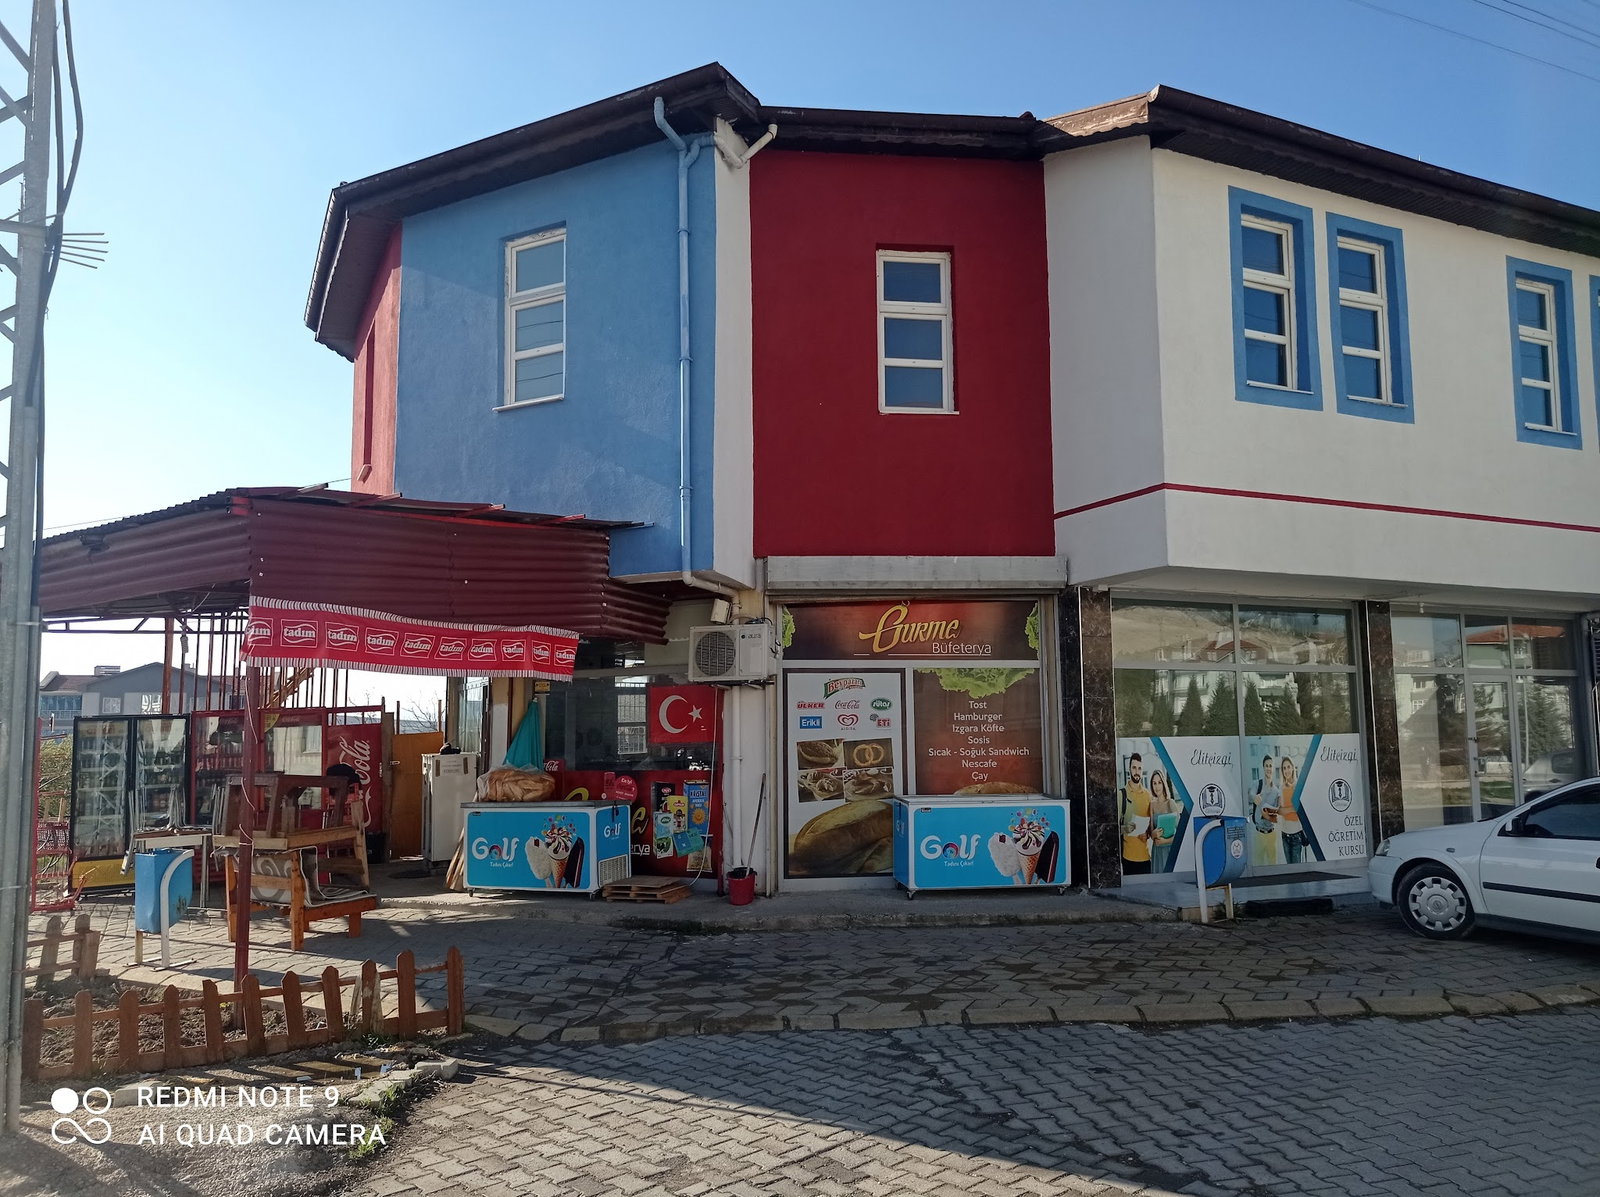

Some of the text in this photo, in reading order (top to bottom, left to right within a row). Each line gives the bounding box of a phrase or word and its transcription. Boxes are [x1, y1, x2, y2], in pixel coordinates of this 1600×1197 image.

[284, 627, 316, 639] tadım
[858, 604, 960, 653] Gurme
[328, 630, 358, 642] tadım
[367, 635, 394, 647] tadım
[404, 640, 431, 651] tadım
[440, 644, 464, 653] tadım
[471, 645, 494, 654] tadım
[503, 645, 524, 654] tadım
[932, 642, 992, 656] Büfeterya
[533, 647, 550, 657] tadım
[968, 700, 988, 710] Tost
[953, 712, 1003, 723] Hamburger
[952, 723, 1005, 735] Izgara Köfte
[967, 736, 991, 745] Sosis
[928, 747, 952, 757] Sıcak
[959, 747, 986, 759] Soğuk
[988, 746, 1030, 756] Sandwich
[961, 759, 998, 768] Nescafe
[971, 771, 989, 782] Çay
[1344, 815, 1363, 827] ÖZEL
[604, 822, 622, 838] Golf
[472, 837, 519, 862] Golf
[920, 834, 981, 860] Golf
[1339, 844, 1365, 857] KURSU
